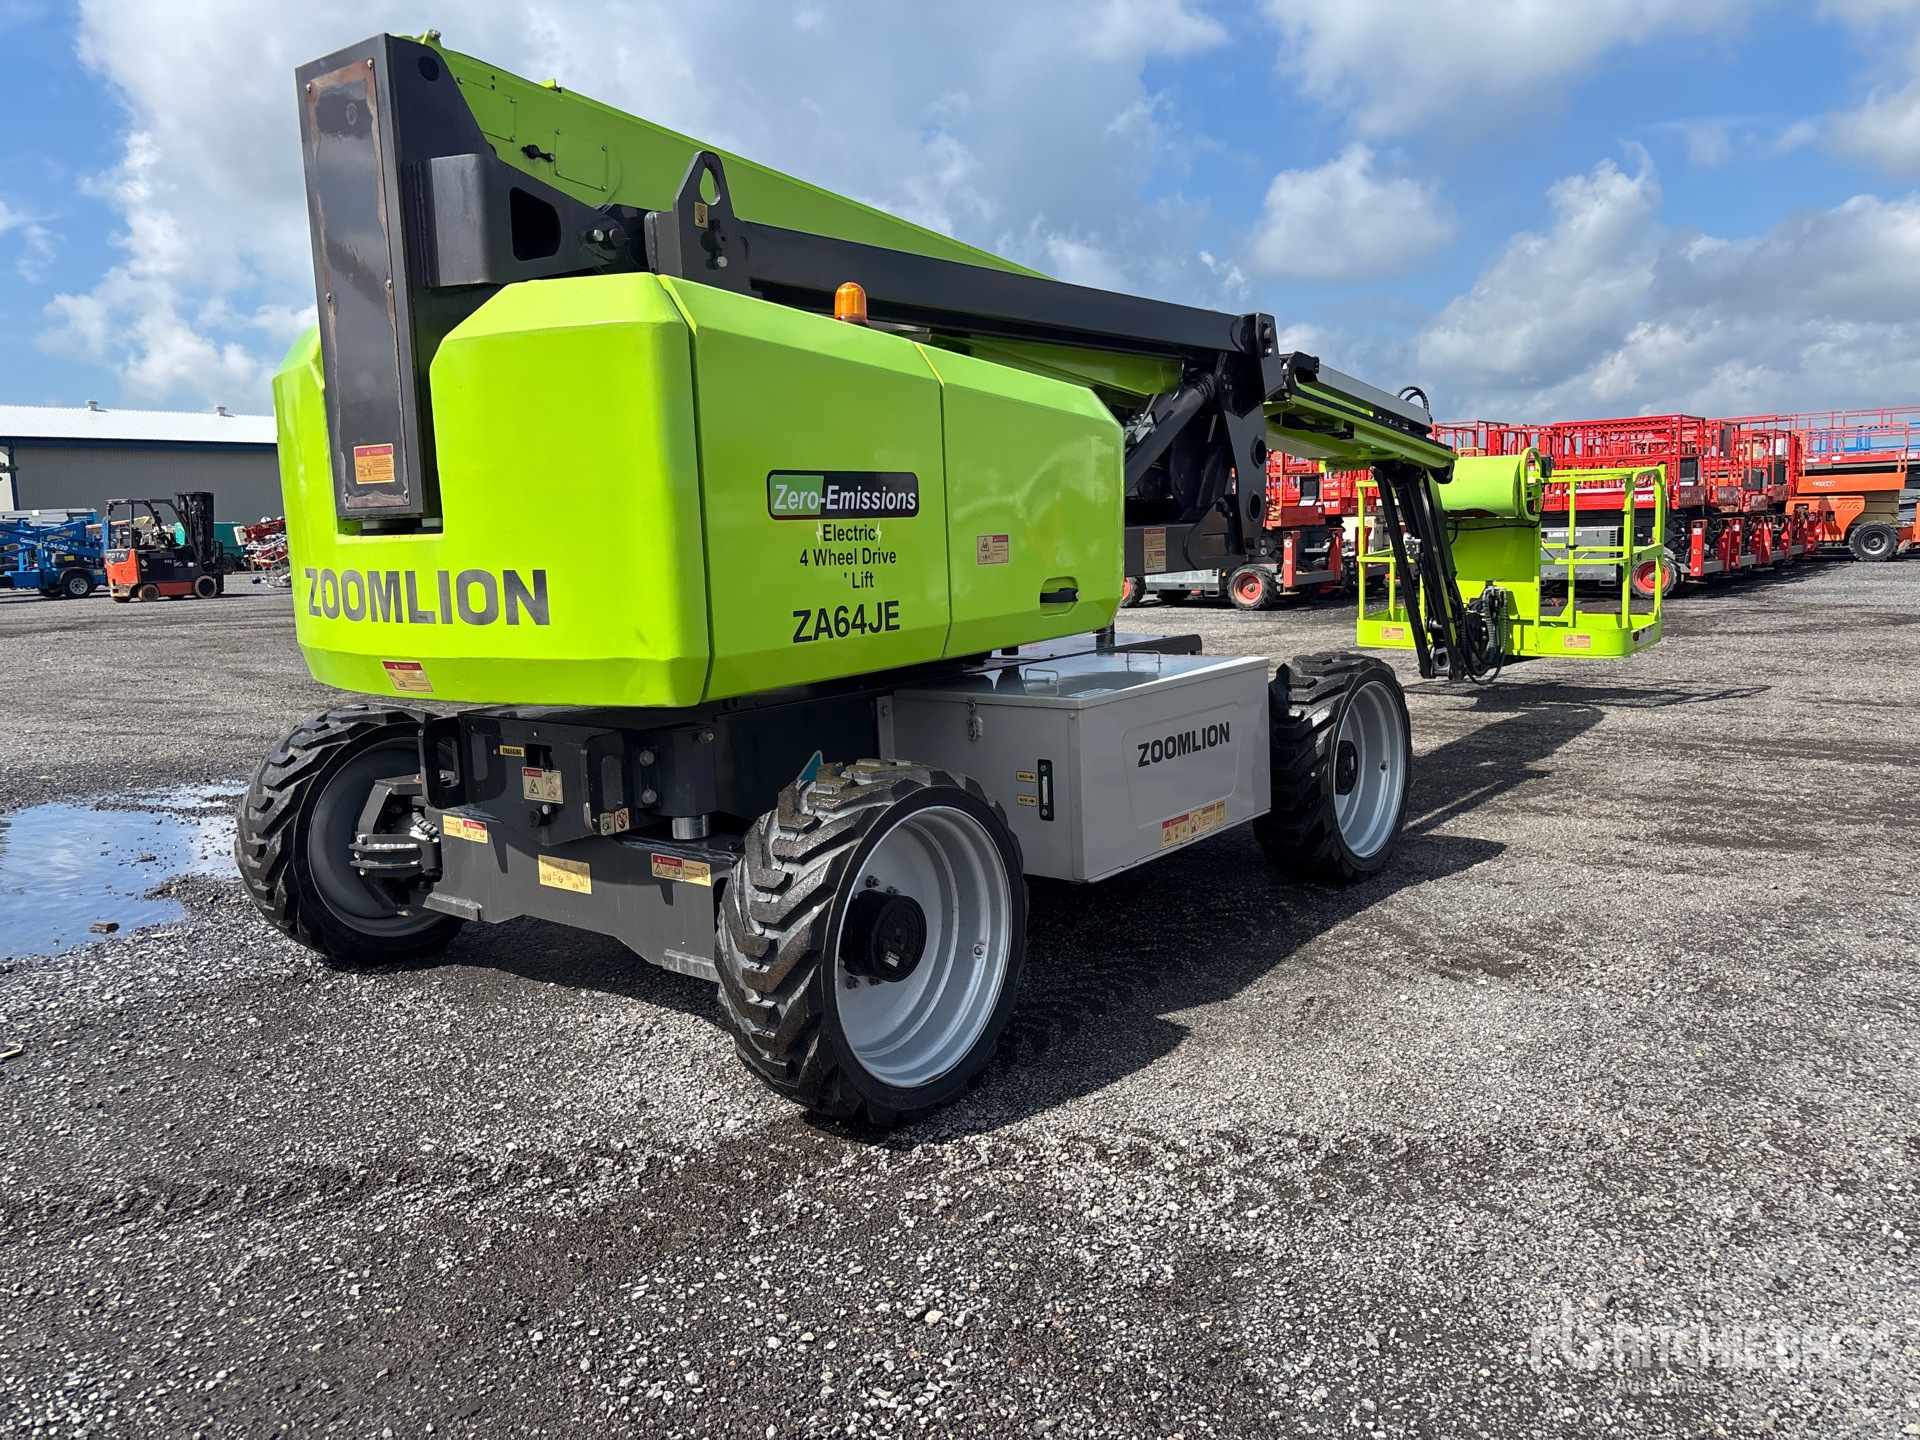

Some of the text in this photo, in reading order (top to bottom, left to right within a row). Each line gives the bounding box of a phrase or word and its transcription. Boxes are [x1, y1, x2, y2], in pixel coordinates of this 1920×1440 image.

[774, 484, 917, 510] Zero-Emissions
[1836, 502, 1860, 510] JLG
[823, 524, 876, 541] Electric
[800, 548, 897, 566] 4 Wheel Drive
[852, 571, 874, 589] Lift
[305, 568, 550, 626] ZOOMLION
[793, 600, 900, 644] ZA64JE
[502, 747, 522, 756] CHARGING
[1137, 722, 1230, 767] ZOOMLION
